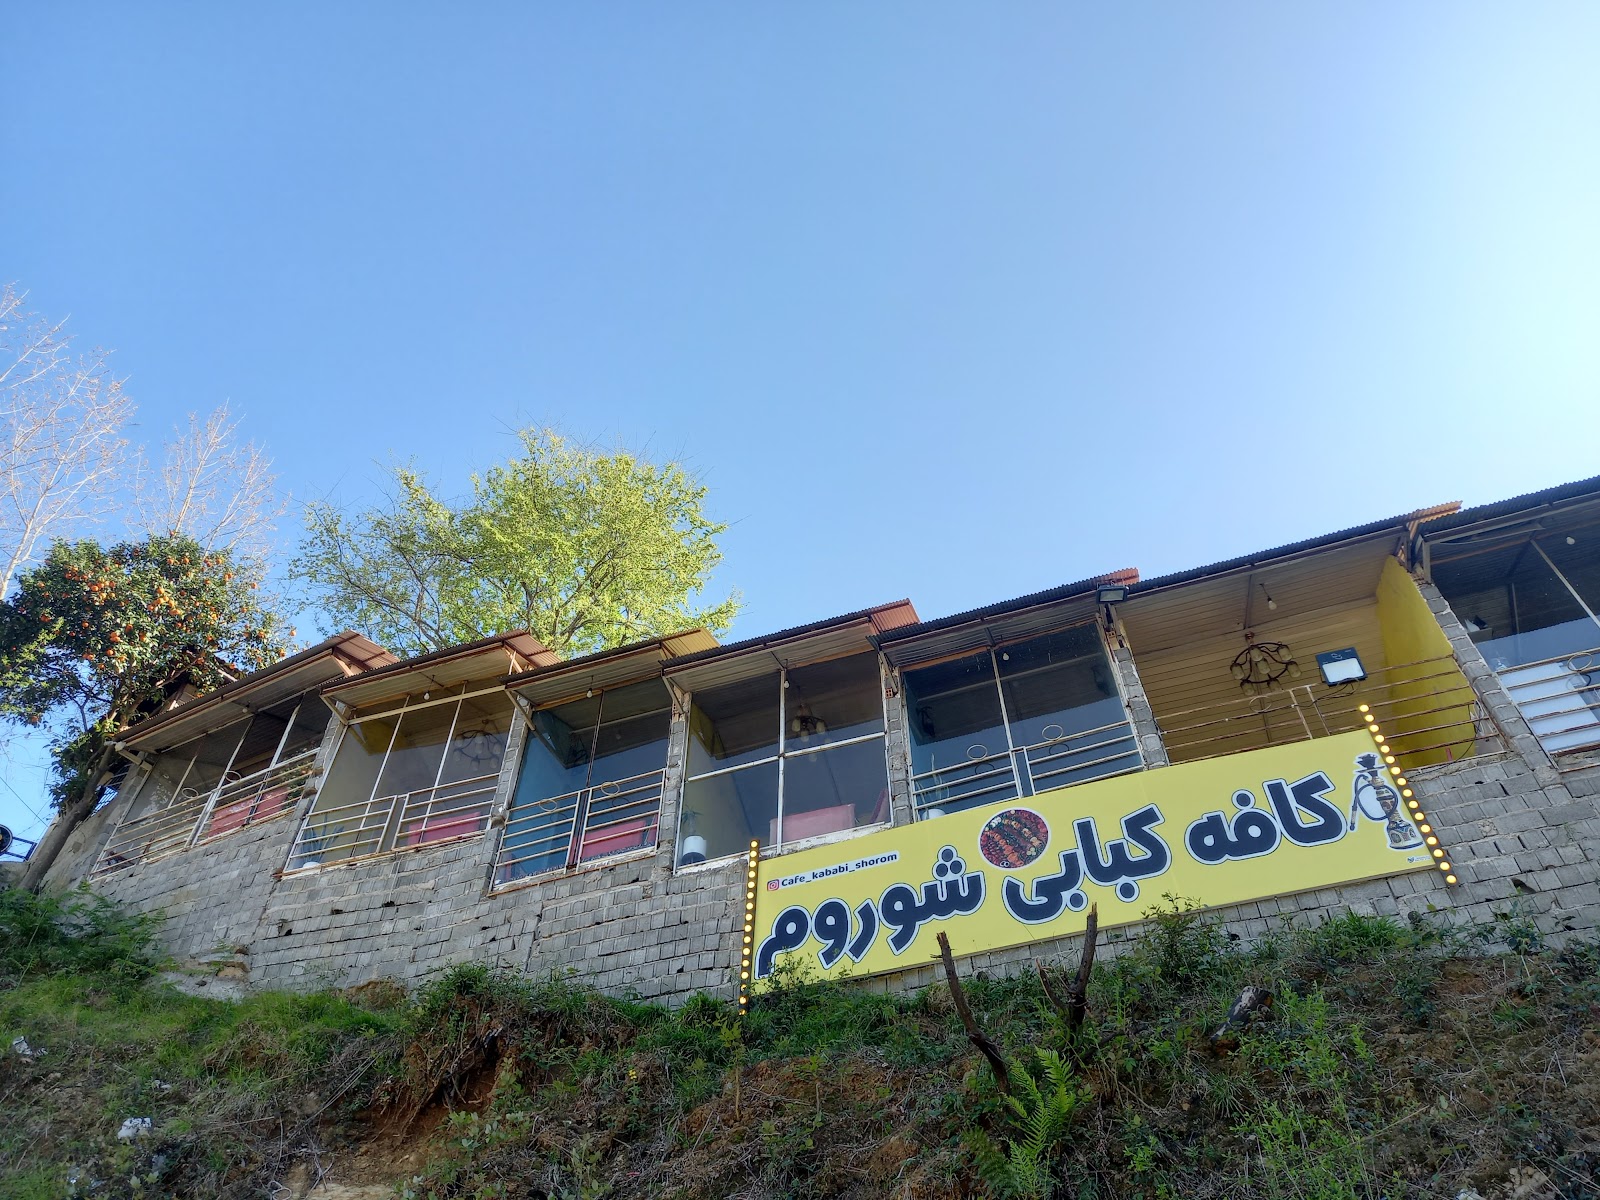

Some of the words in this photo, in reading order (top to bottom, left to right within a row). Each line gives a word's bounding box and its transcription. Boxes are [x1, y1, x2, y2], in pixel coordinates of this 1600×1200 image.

[781, 853, 898, 887] Cafe_kababi_shorom
[1003, 804, 1170, 923] کبابی
[1187, 773, 1344, 863] کافه
[756, 847, 984, 979] شوروم
